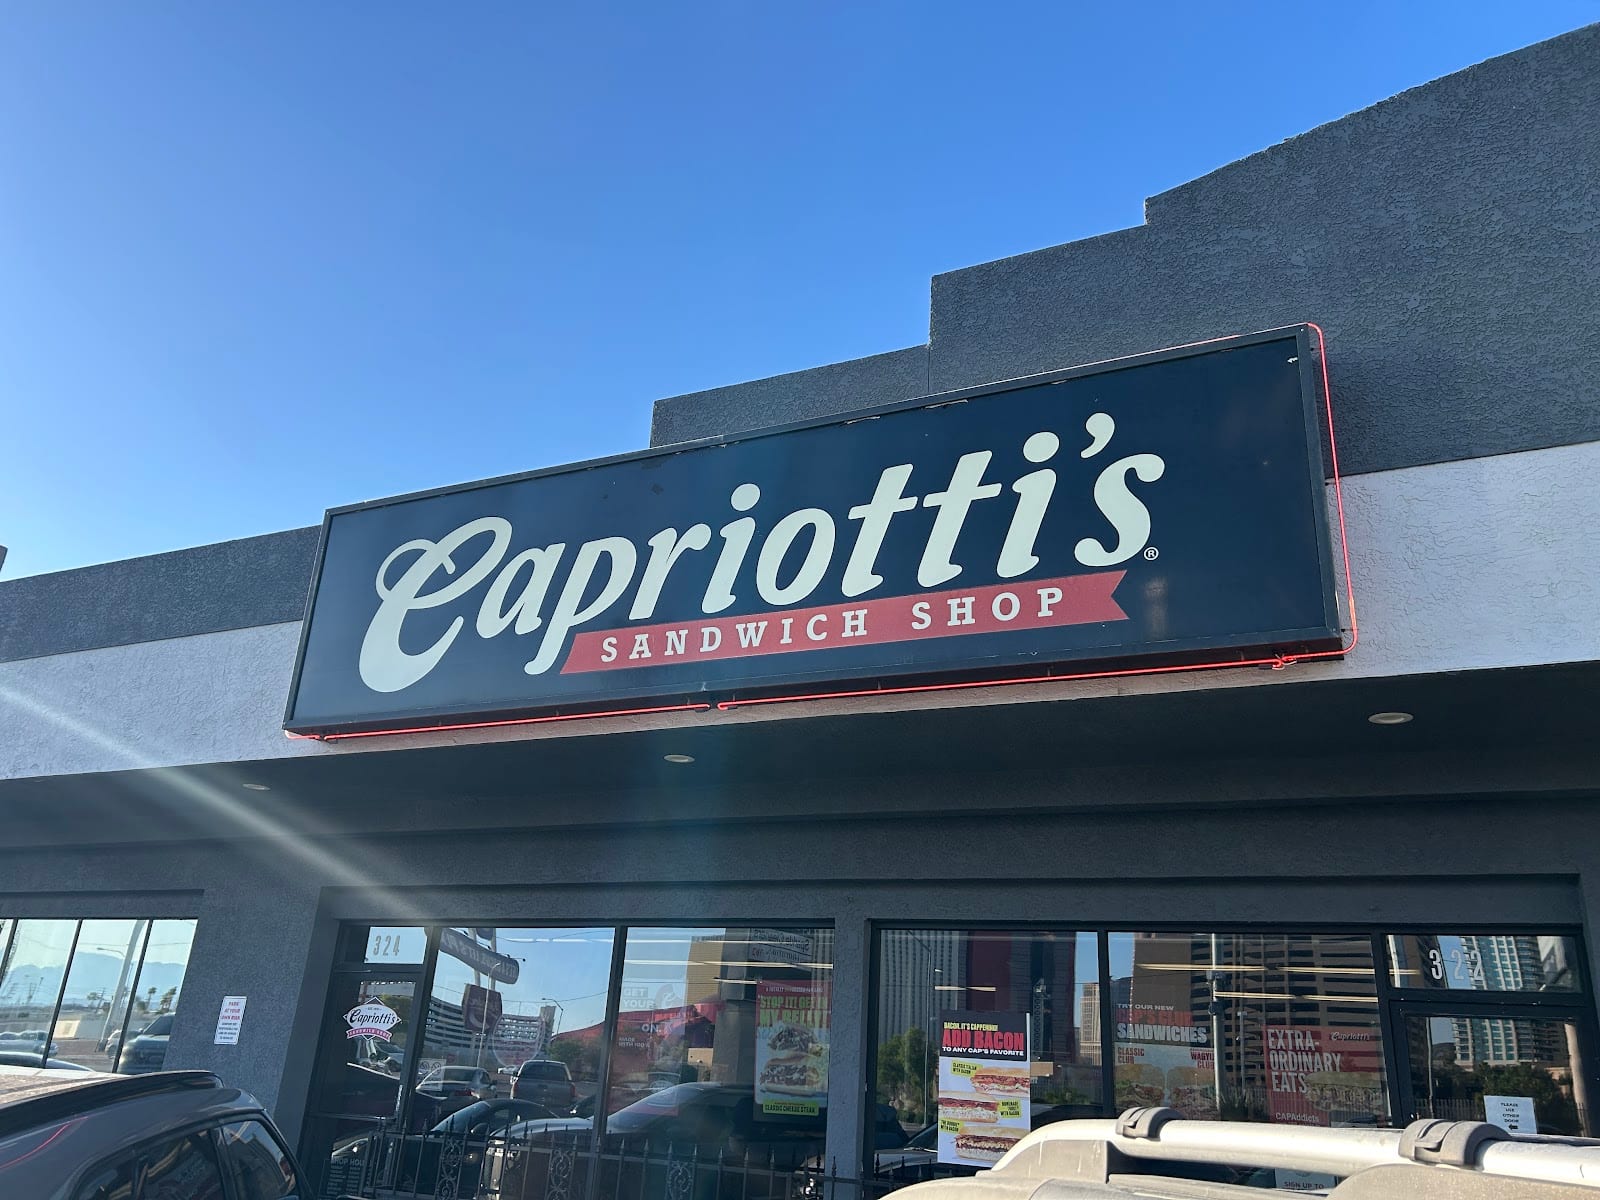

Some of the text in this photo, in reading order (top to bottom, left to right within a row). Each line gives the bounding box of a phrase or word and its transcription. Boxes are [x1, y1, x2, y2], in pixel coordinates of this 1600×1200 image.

[358, 412, 1166, 693] Capriotti's
[600, 587, 1064, 663] SANDWICH SHOP
[373, 935, 401, 957] 324
[1429, 949, 1485, 981] 322
[349, 1008, 396, 1026] Capriotti's
[942, 1029, 1024, 1051] ADD BACON
[1117, 1023, 1208, 1044] SANDWICHES
[1267, 1029, 1320, 1051] EXTRA-
[1117, 1047, 1145, 1056] CLASSIC
[1269, 1050, 1342, 1073] ORDINARY
[1275, 1112, 1320, 1123] CAPAddicts
[1283, 1181, 1301, 1189] SIGN
